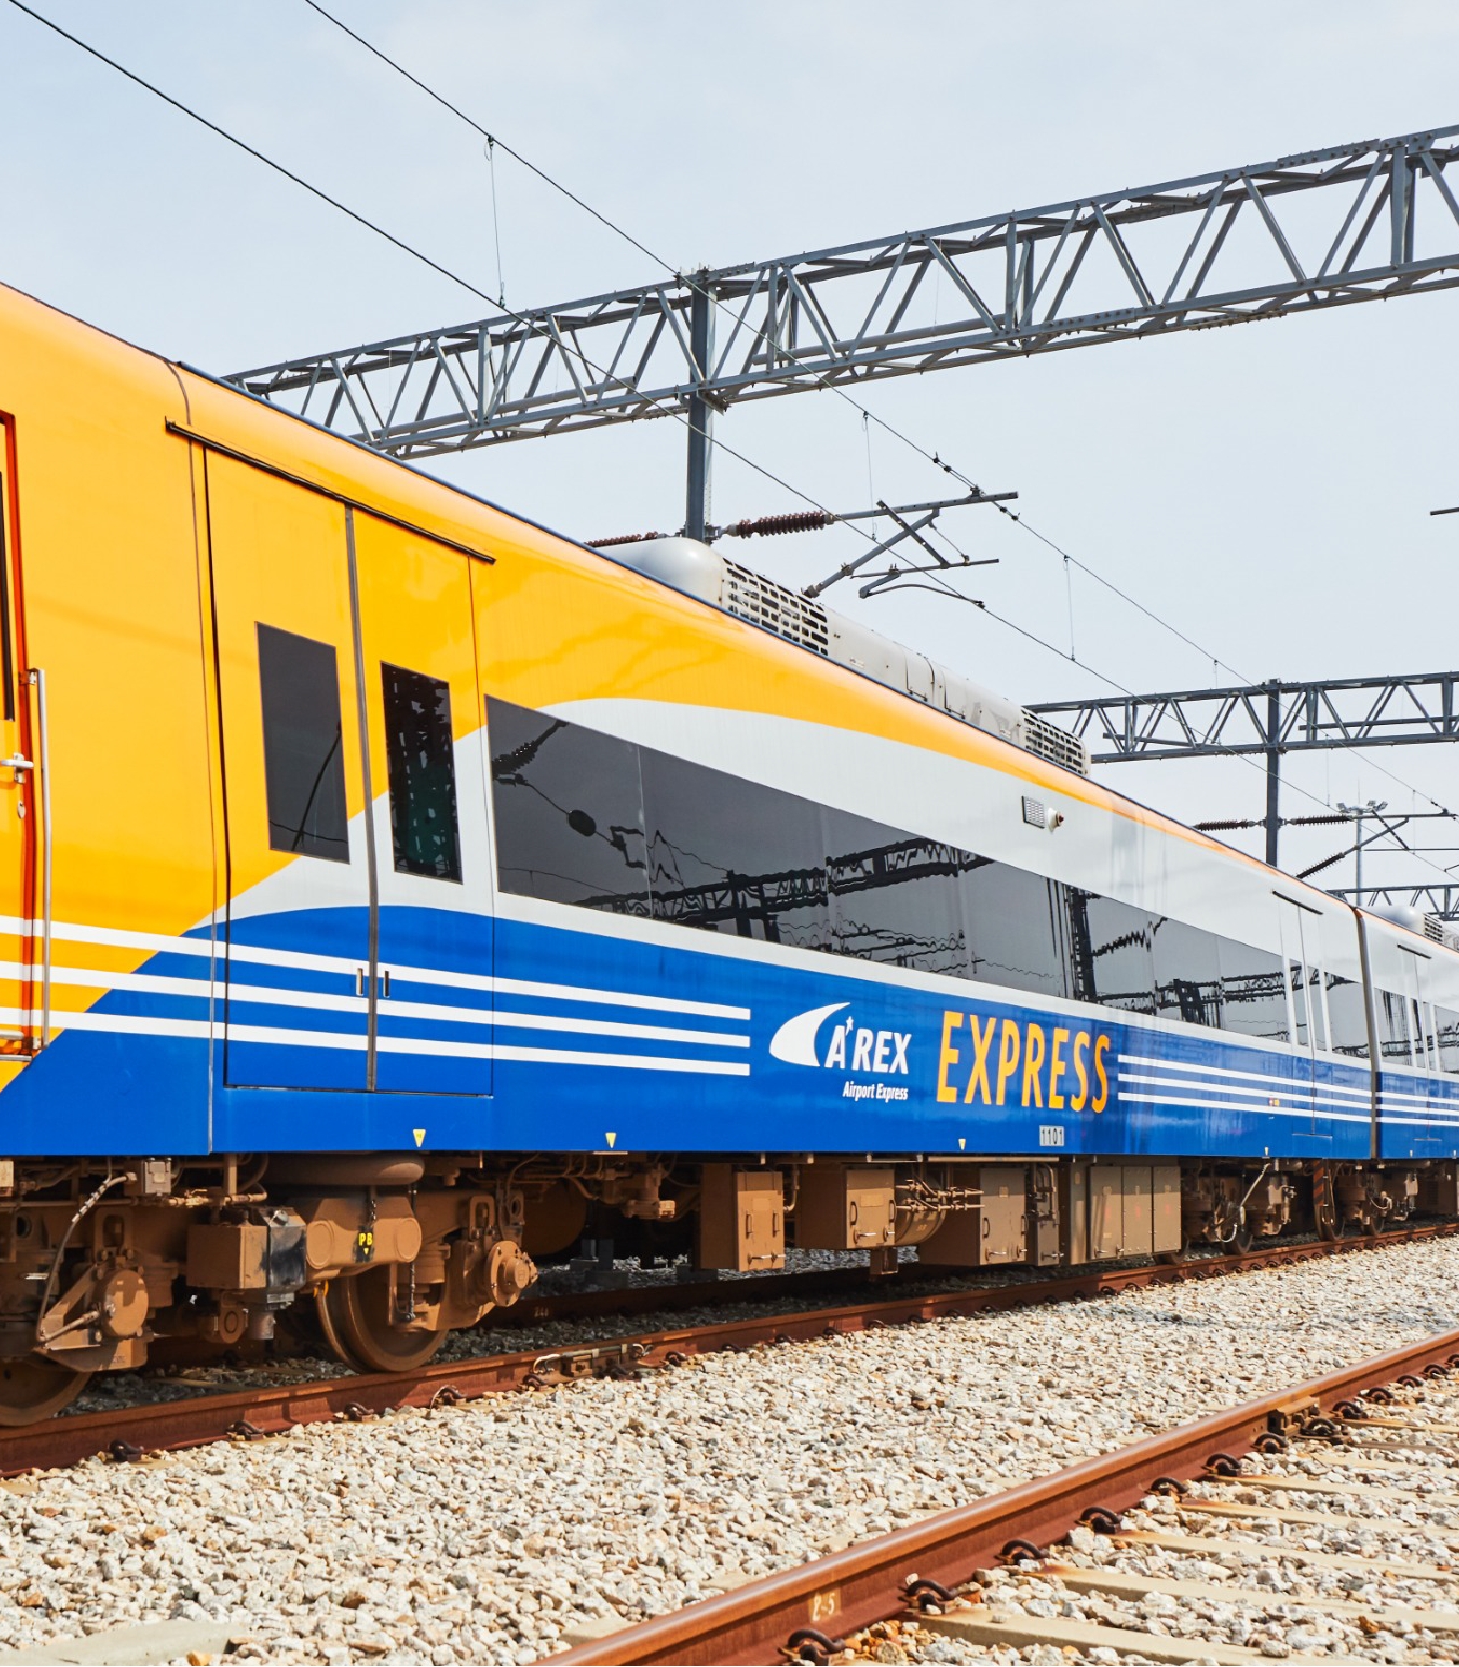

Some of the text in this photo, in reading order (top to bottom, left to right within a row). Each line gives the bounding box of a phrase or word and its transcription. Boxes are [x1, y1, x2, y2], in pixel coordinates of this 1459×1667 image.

[824, 1024, 912, 1074] AREX
[936, 1010, 1111, 1114] EXPRESS
[842, 1081, 909, 1103] Airport Express
[1041, 1127, 1063, 1145] 1101
